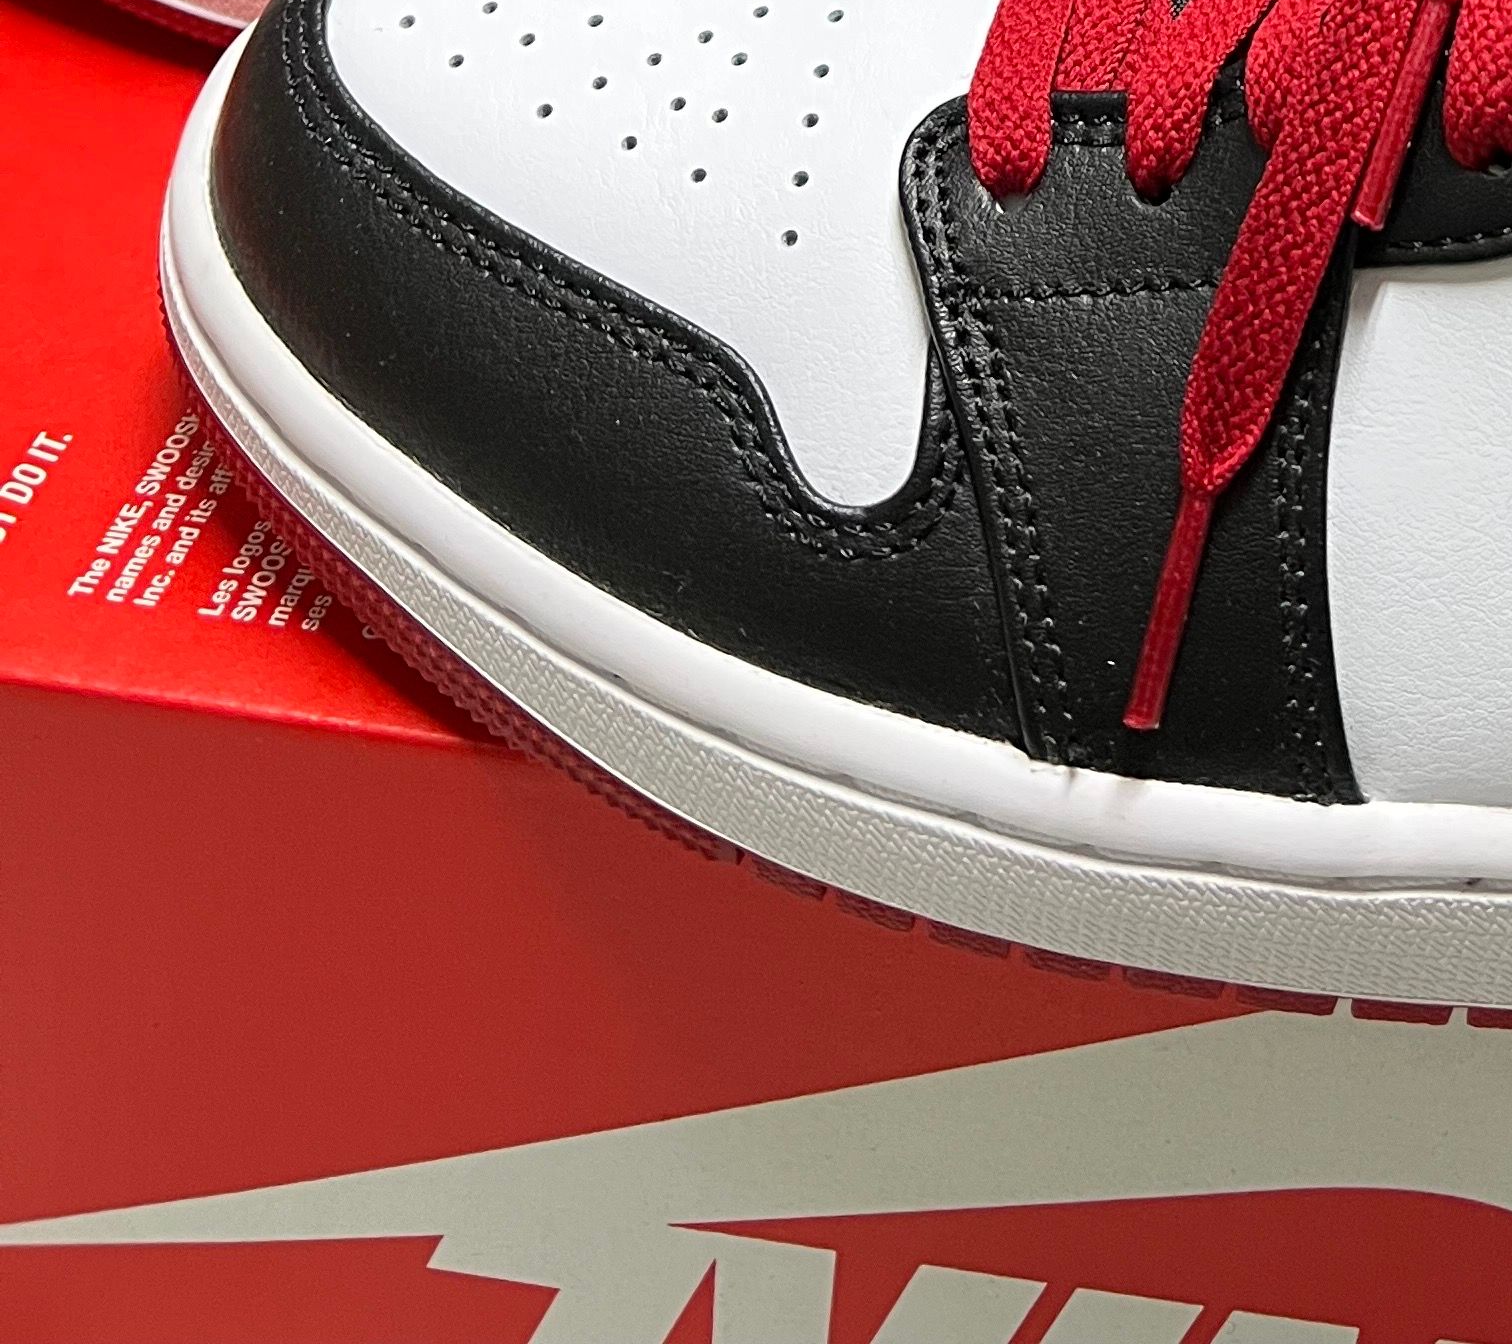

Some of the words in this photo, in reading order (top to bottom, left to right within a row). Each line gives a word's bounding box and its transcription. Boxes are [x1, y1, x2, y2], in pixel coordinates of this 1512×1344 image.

[0, 463, 47, 505] DO
[27, 431, 73, 463] IT.
[67, 558, 111, 596] The
[96, 501, 154, 555] NIKE,
[106, 534, 161, 602] names
[152, 493, 187, 531] and
[133, 569, 175, 606] Inc.
[166, 526, 200, 566] and
[184, 498, 217, 523] its
[198, 578, 239, 616] Les
[222, 520, 272, 575] logos
[301, 594, 333, 632] ses
